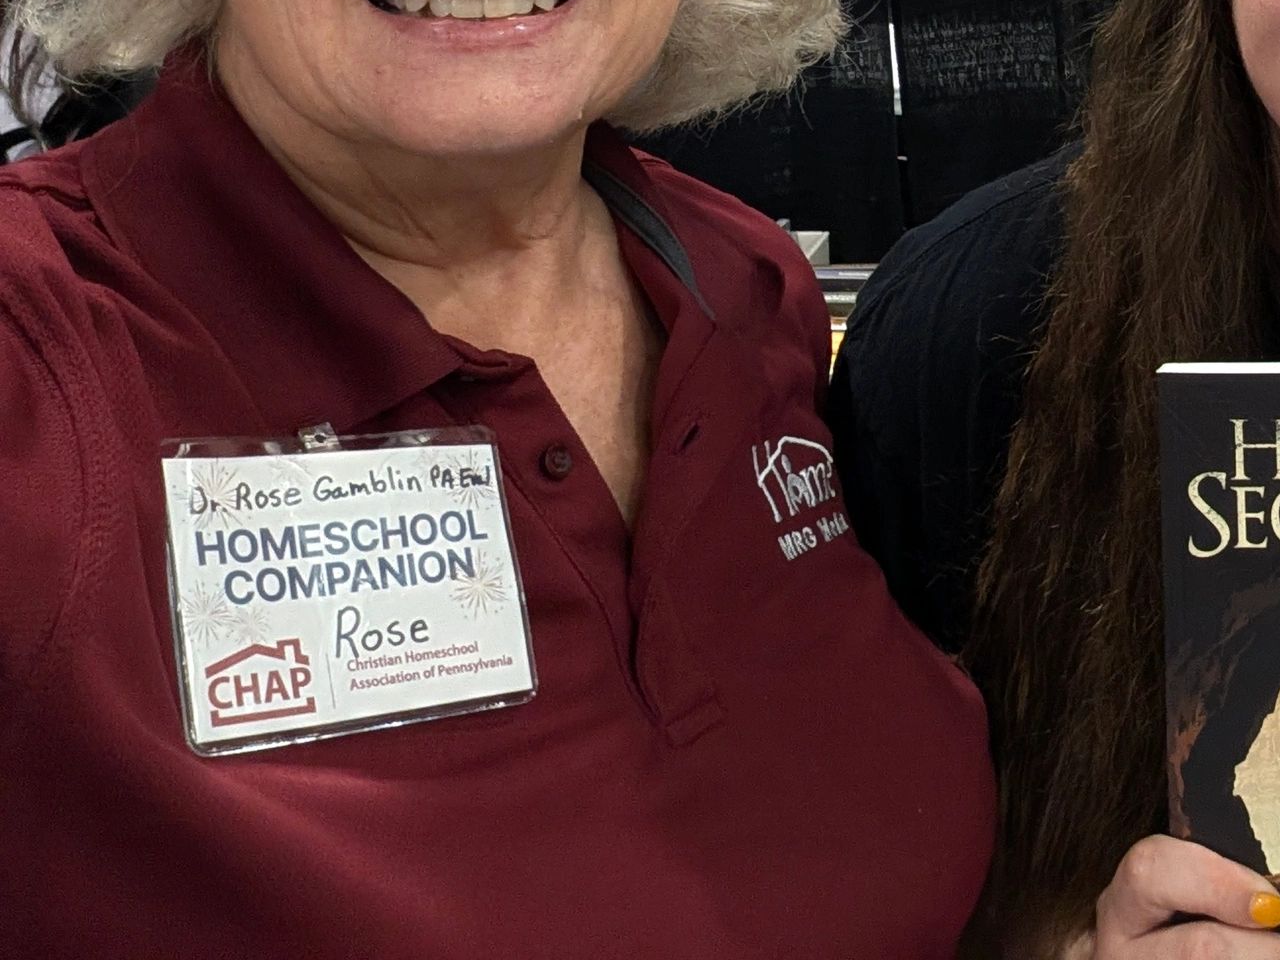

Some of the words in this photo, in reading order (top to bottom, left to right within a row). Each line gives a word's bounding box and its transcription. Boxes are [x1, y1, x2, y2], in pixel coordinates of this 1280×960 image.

[235, 481, 302, 510] Rose
[313, 466, 422, 501] Gamblin
[195, 510, 488, 565] HOMESCHOOL
[224, 547, 476, 605] COMPANION
[336, 606, 429, 659] Rose
[347, 653, 402, 672] Christian
[405, 641, 479, 663] Homeschool
[350, 669, 421, 690] Association
[424, 665, 436, 679] of
[438, 655, 513, 677] Pennsylvania
[208, 667, 311, 709] CHAP
